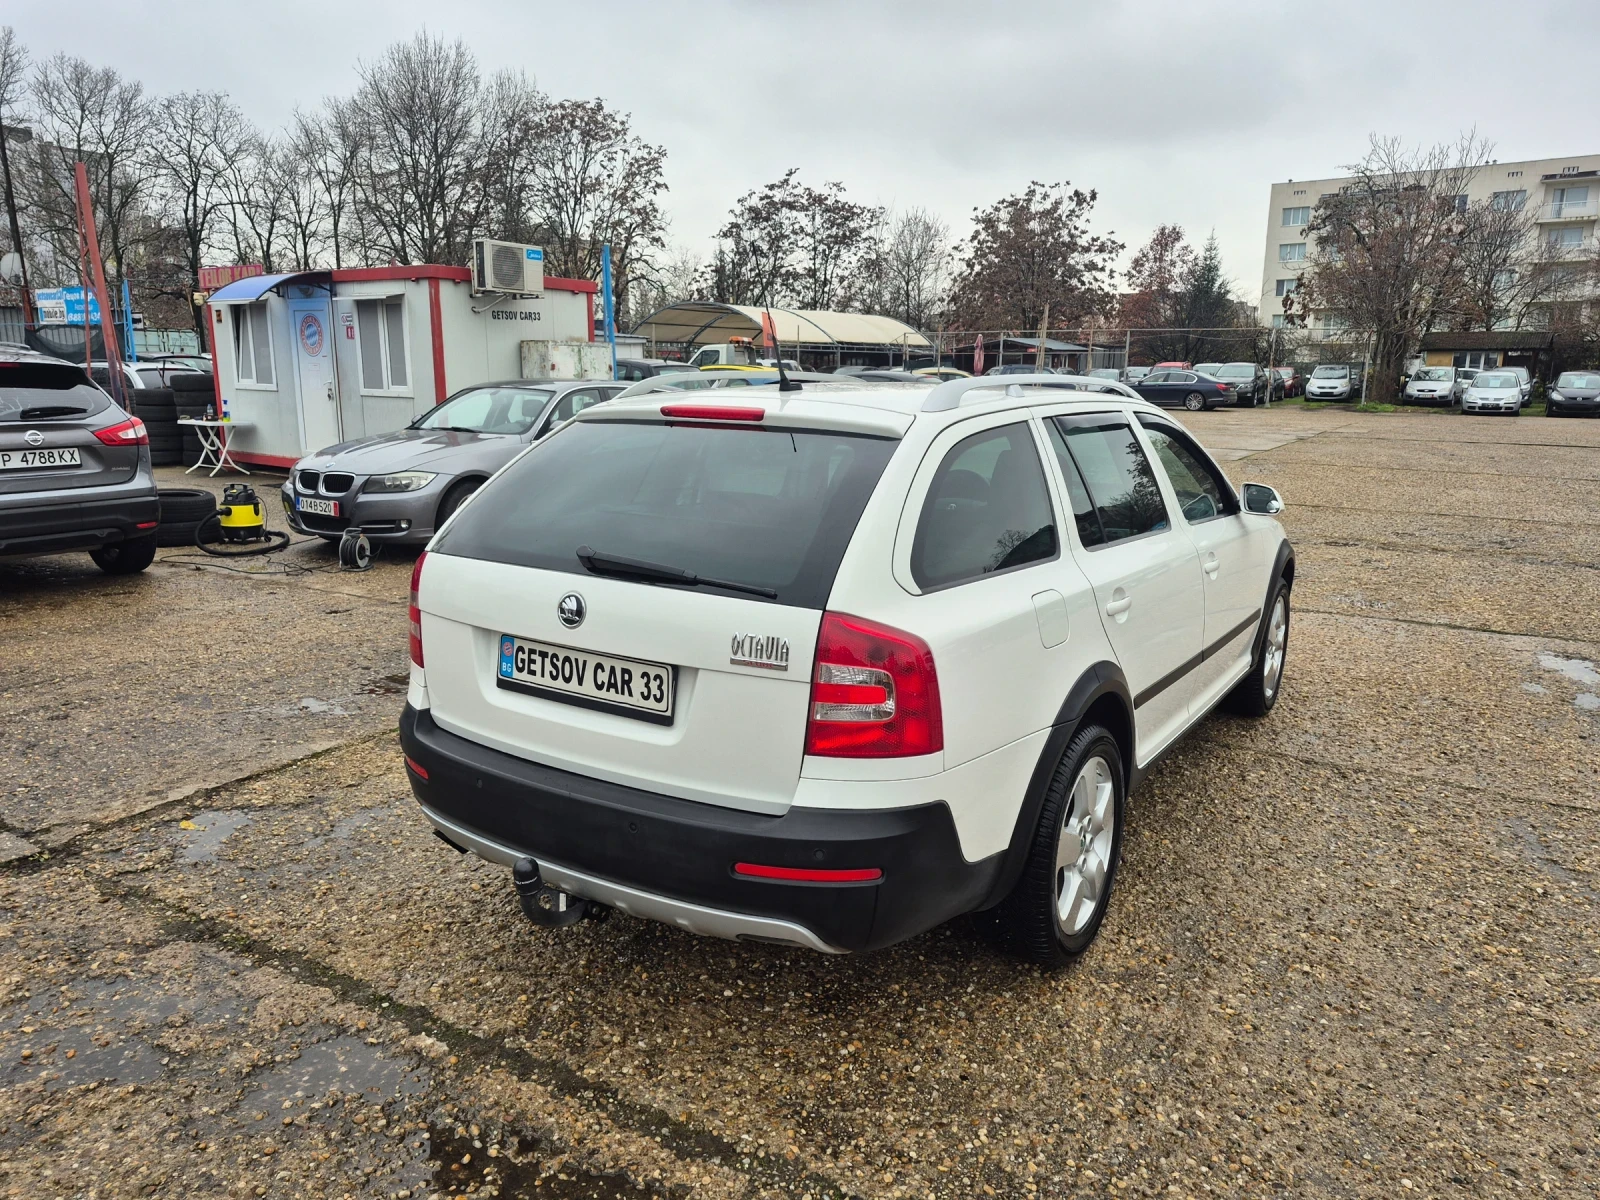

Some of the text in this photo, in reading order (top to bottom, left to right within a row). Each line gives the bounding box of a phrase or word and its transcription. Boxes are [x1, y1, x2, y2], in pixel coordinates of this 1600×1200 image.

[492, 310, 541, 321] GETSOV CAR33
[1, 453, 11, 467] P
[731, 631, 790, 662] OCTAVIA
[502, 662, 512, 672] BG
[514, 645, 664, 704] GETSOV CAR 33
